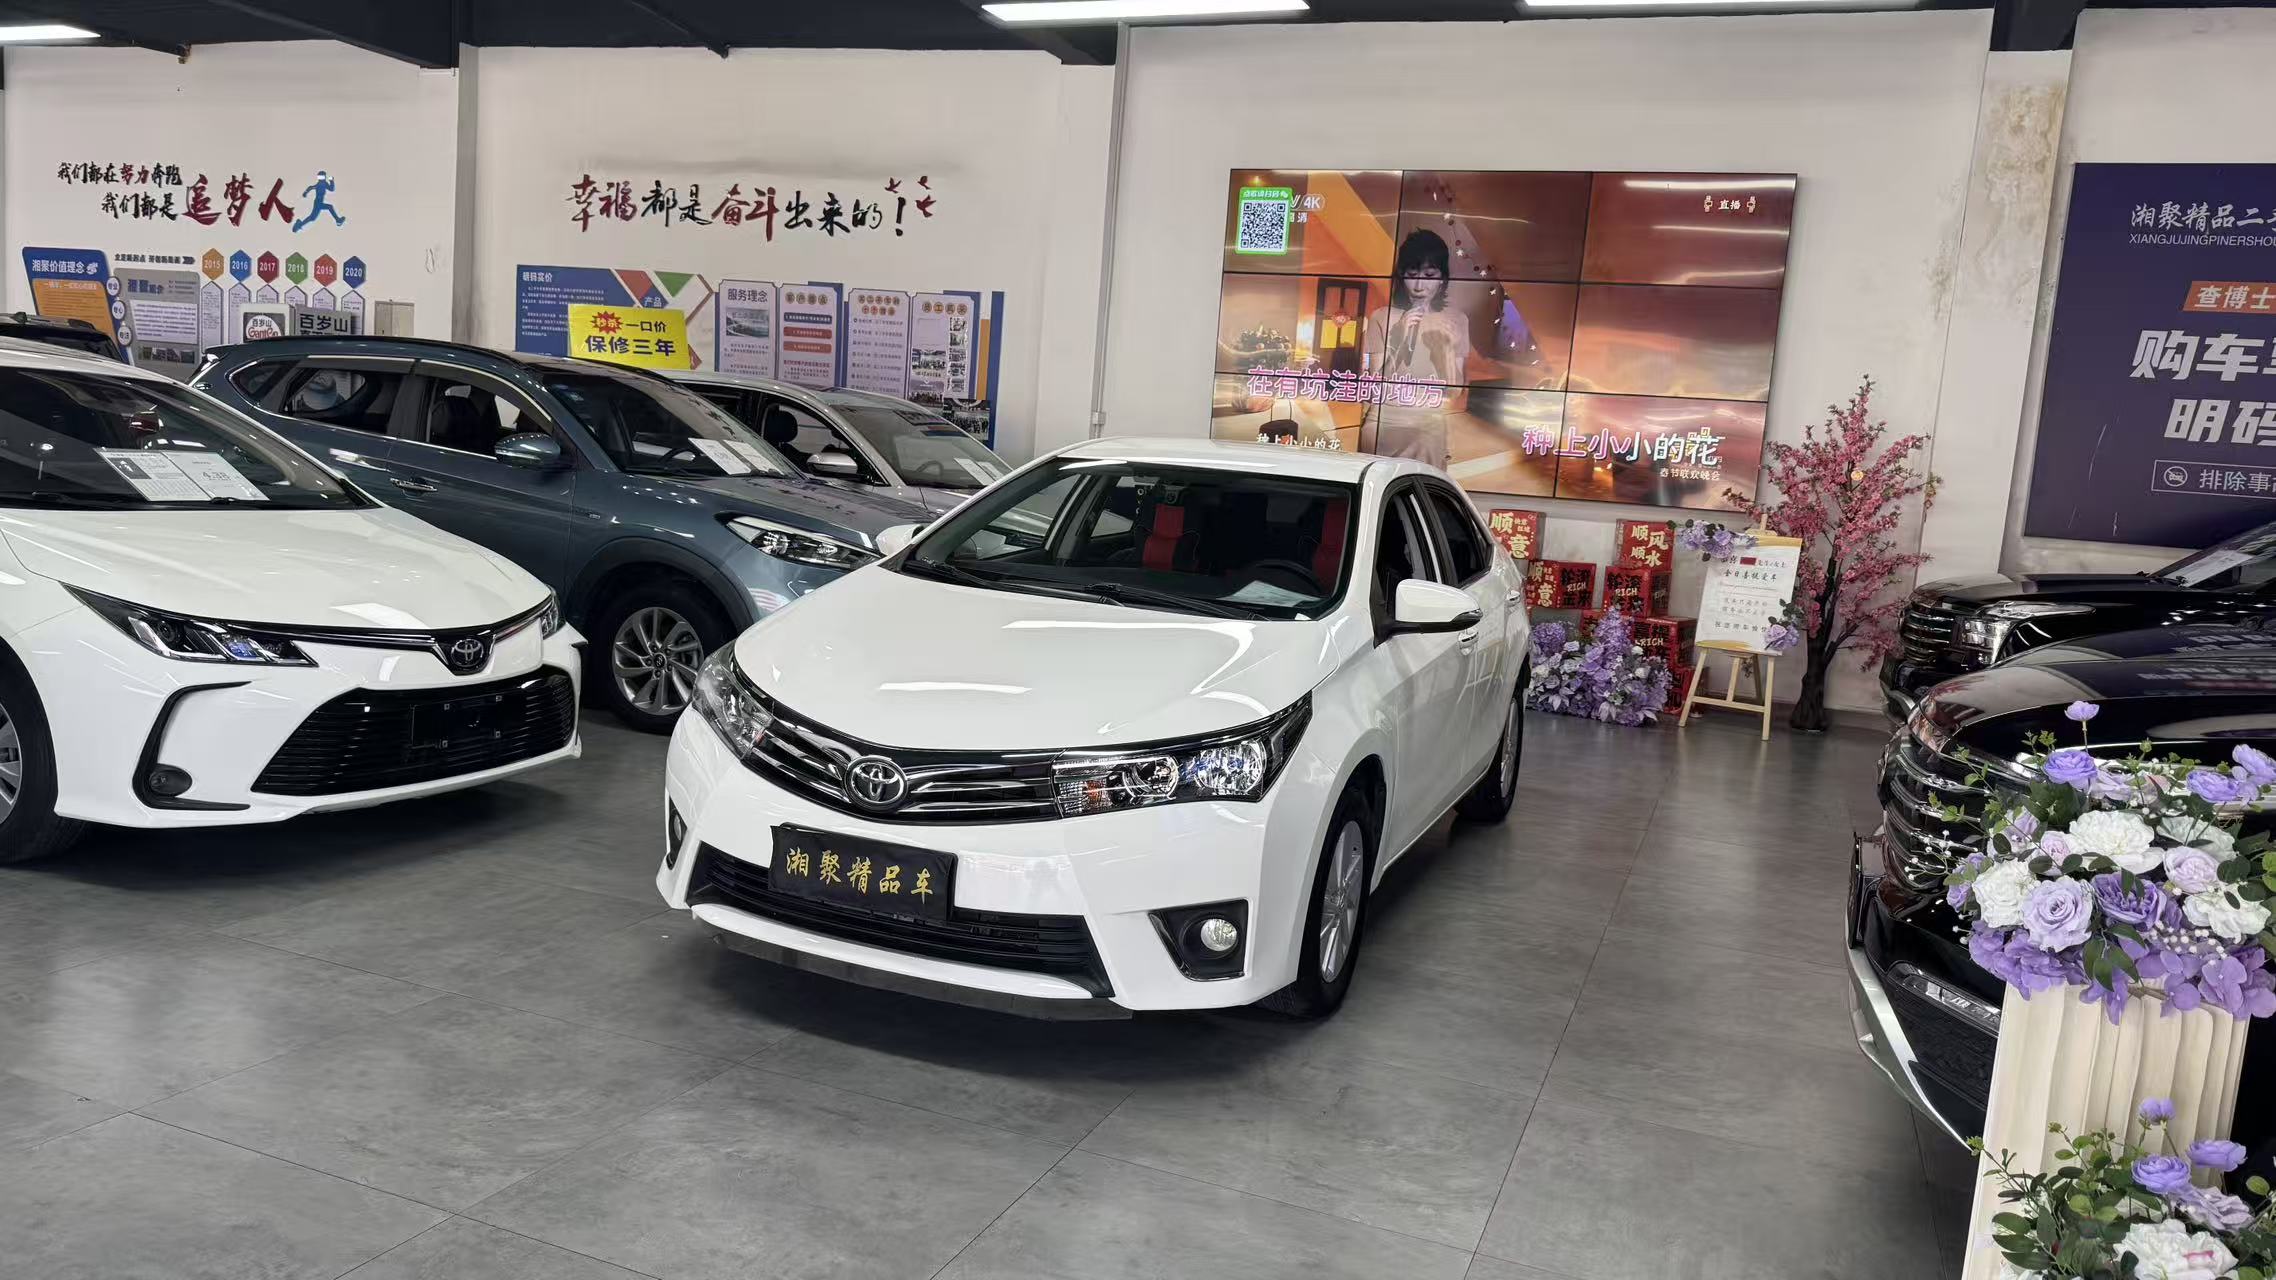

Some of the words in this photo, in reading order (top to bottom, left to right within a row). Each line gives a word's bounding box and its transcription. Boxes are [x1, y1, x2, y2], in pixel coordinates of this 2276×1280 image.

[56, 161, 183, 188] 我们都在努力奔跑
[1718, 199, 1741, 210] 直播
[32, 259, 85, 274] 湘聚价值理念
[204, 260, 221, 270] 2015
[231, 261, 248, 271] 2016
[259, 262, 276, 272] 2017
[287, 263, 305, 273] 2018
[316, 265, 334, 275] 2019
[345, 267, 363, 278] 2020
[727, 287, 768, 303] 服务理念
[2193, 285, 2276, 309] 查博士
[252, 318, 272, 328] 百岁山
[299, 313, 348, 332] 百岁山
[625, 320, 667, 333] 一口价
[585, 334, 676, 356] 保修三年
[1247, 365, 1447, 409] 在有坑洼的地方
[1256, 433, 1342, 451] 种上小小的花
[1521, 425, 1720, 466] 种上小小的花
[1660, 468, 1721, 481] 春节联欢晚会
[1566, 582, 1587, 592] RICH
[1614, 587, 1638, 597] RICH
[1640, 637, 1664, 647] RICH
[786, 847, 933, 905] 湘聚精品车
